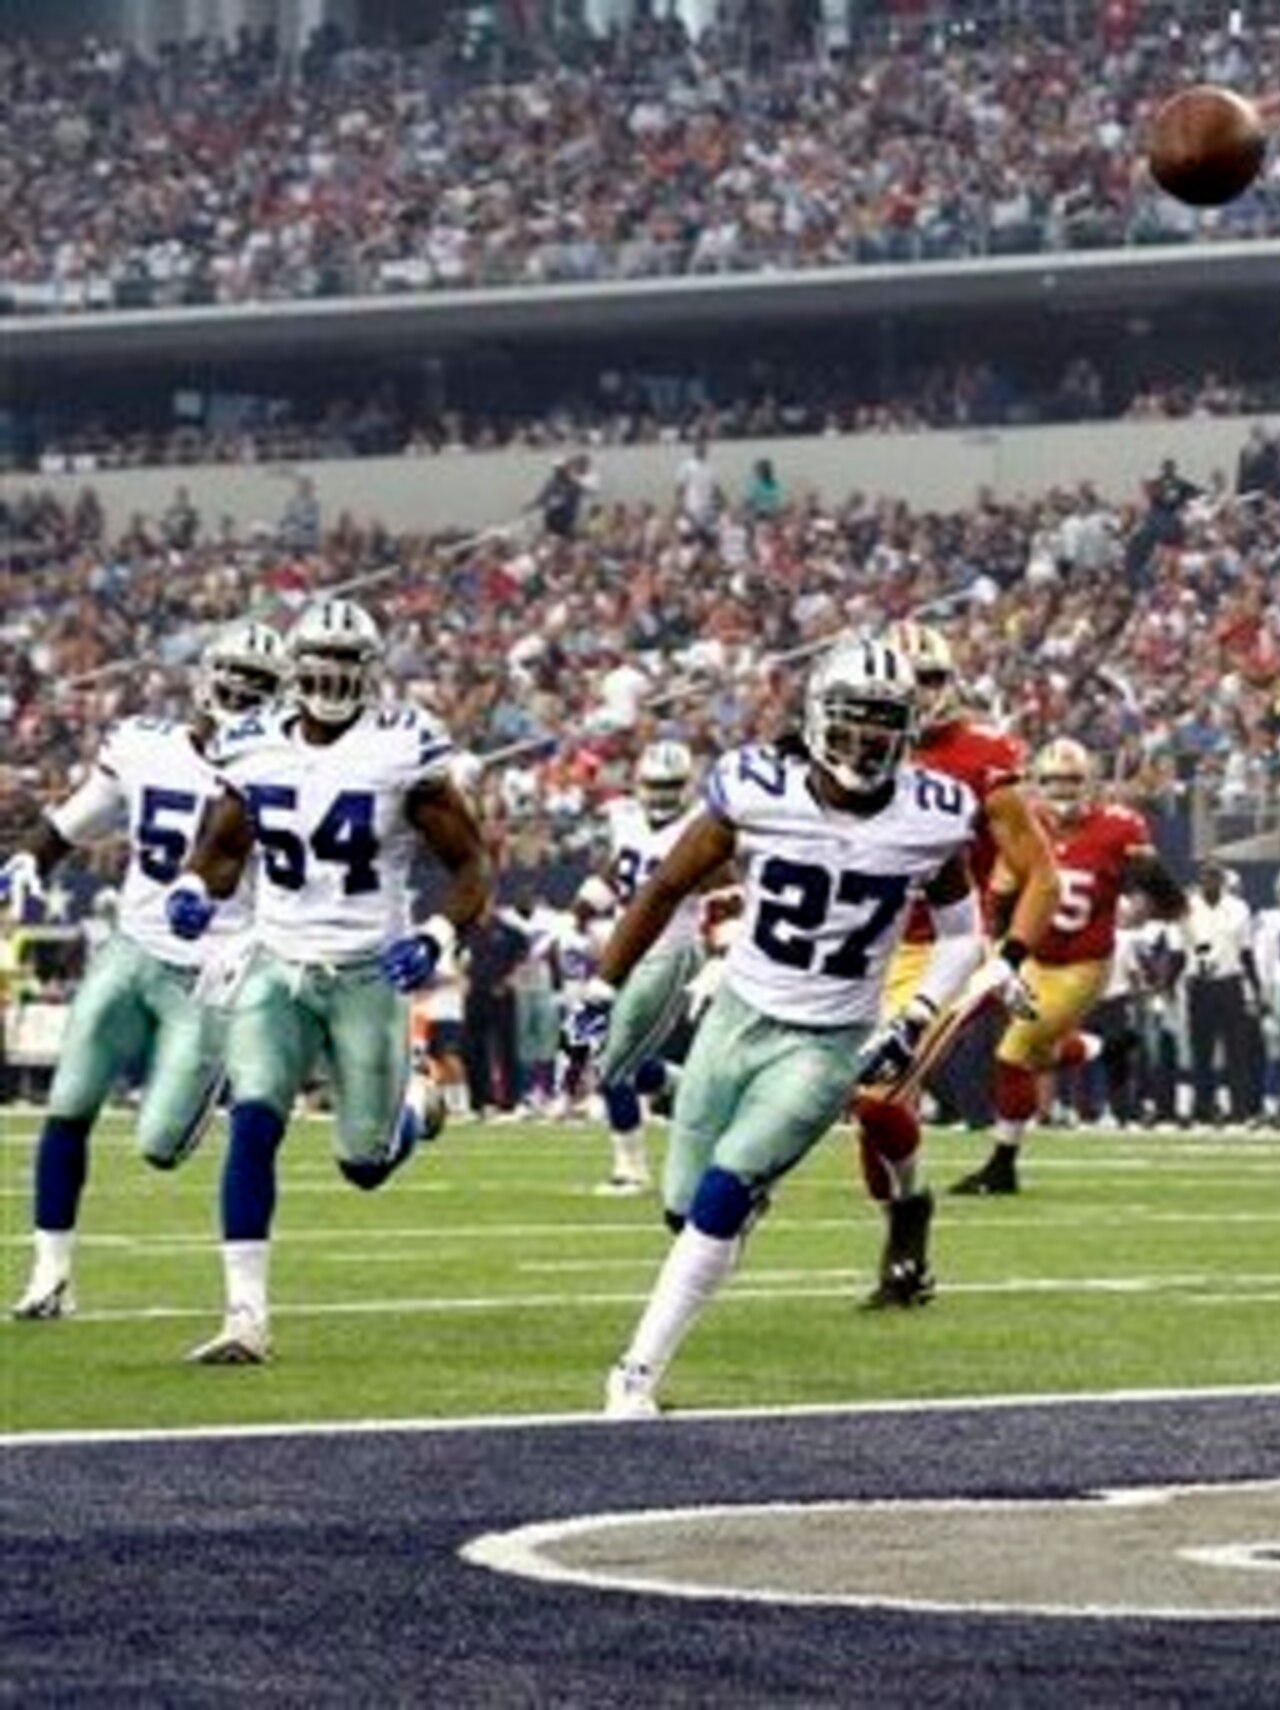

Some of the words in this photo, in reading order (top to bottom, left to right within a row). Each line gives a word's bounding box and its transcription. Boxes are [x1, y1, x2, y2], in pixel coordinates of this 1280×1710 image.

[138, 785, 197, 883] 5
[246, 783, 381, 895] 54
[754, 856, 910, 979] 27
[1054, 869, 1094, 931] 5
